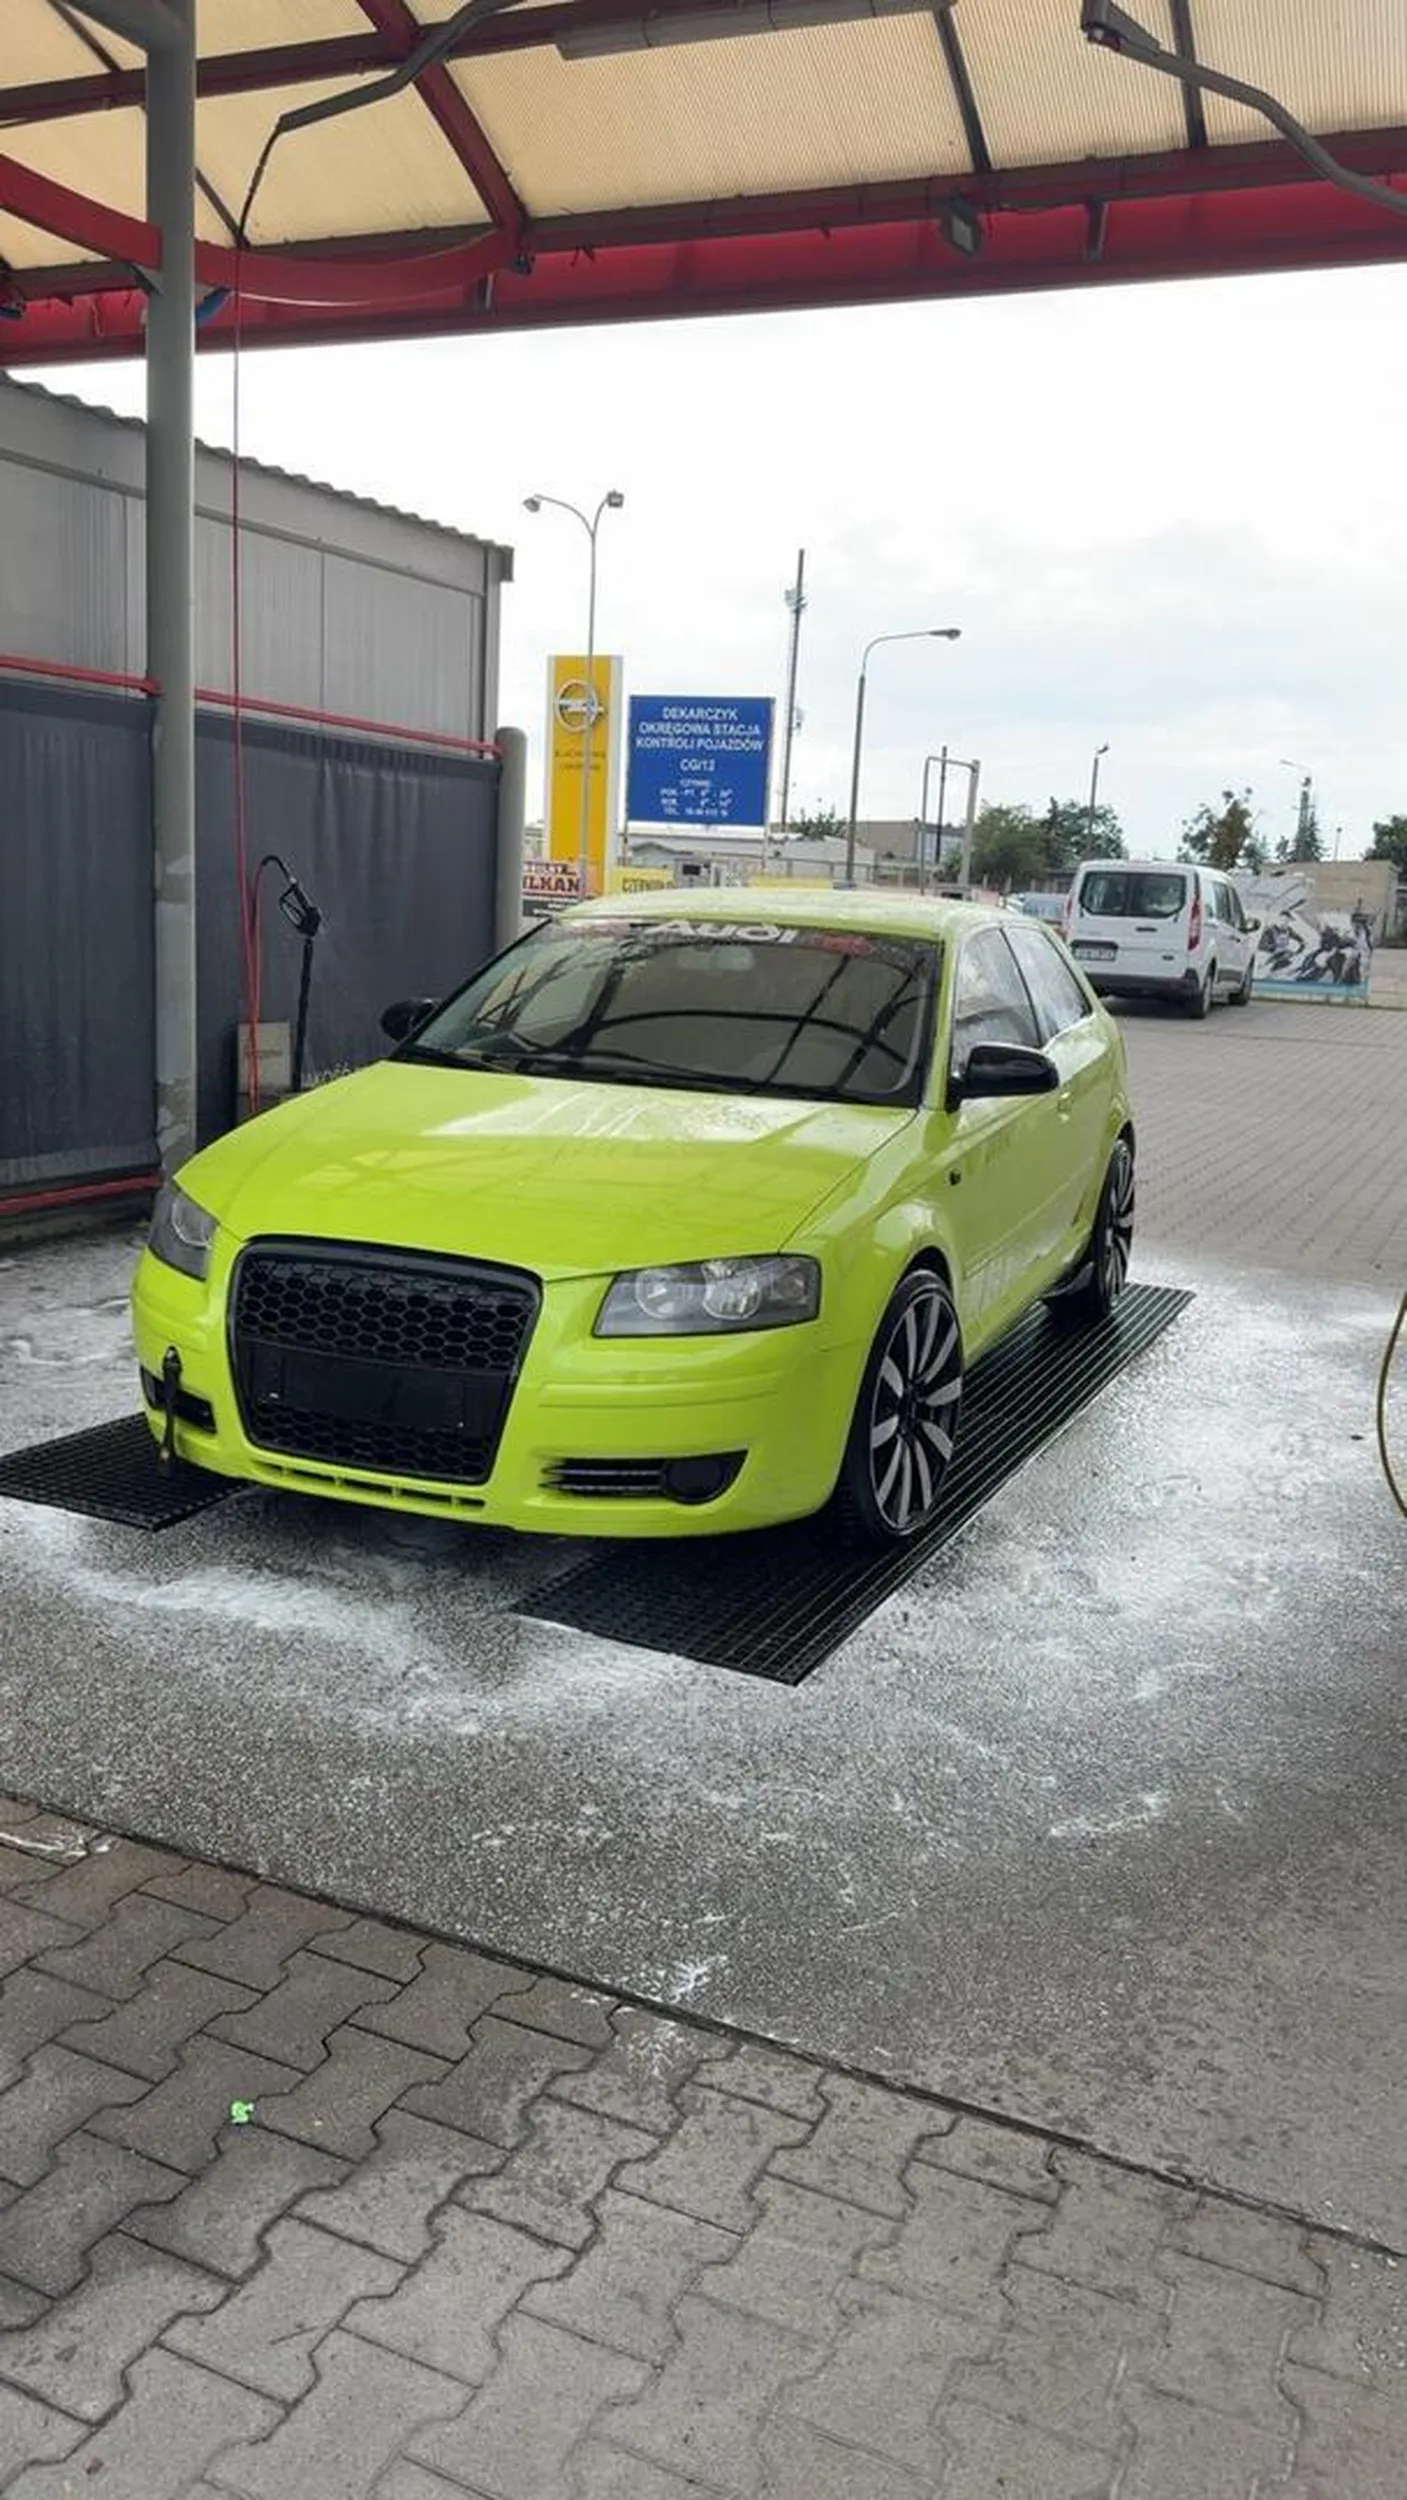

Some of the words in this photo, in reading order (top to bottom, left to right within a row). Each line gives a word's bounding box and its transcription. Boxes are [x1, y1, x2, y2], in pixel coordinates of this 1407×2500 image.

[662, 706, 739, 721] DEKARCZYK
[638, 721, 711, 737] OKRĘGOWA
[712, 722, 761, 736] STACJA
[636, 736, 695, 749] KONTROLI
[696, 737, 763, 752] POJAZDÓW
